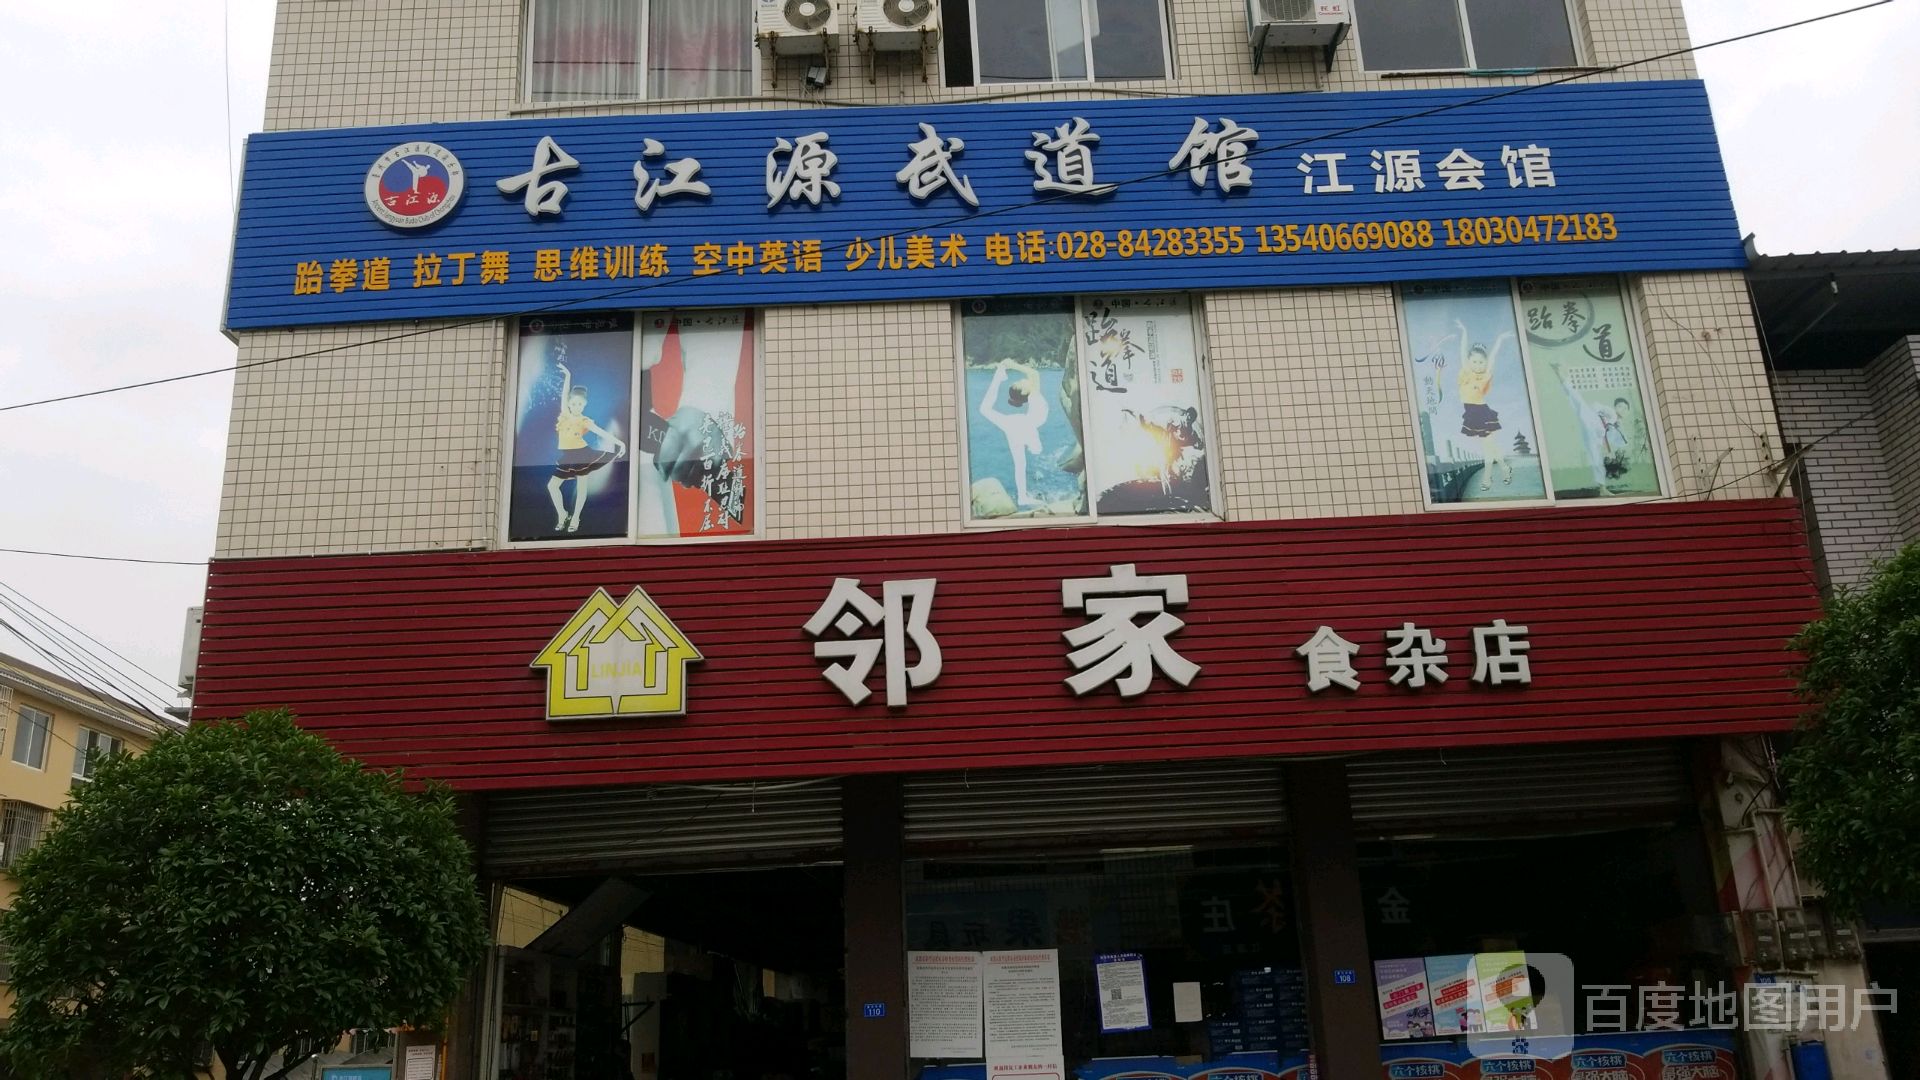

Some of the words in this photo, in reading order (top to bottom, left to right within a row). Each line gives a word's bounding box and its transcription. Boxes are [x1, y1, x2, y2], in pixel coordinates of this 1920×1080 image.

[496, 116, 1259, 217] 古江源武道馆
[1297, 145, 1557, 195] 江源会馆
[294, 257, 390, 295] 跆拳道
[413, 251, 509, 289] 拉丁舞
[534, 245, 670, 282] 思维训练
[693, 240, 822, 276] 空中英语
[845, 233, 968, 272] 少儿美术
[986, 226, 1244, 265] 电话:028-84283355
[1257, 221, 1434, 253] 13540669088
[1443, 213, 1618, 246] 18030472183
[1527, 301, 1626, 363] 跆拳道
[803, 563, 1202, 707] 邻家
[1296, 618, 1532, 693] 食杂店
[591, 662, 642, 678] LINJIA
[868, 1008, 881, 1016] 110
[1576, 1055, 1624, 1067] 六个核桃
[1665, 1051, 1713, 1063] 六个核桃
[1393, 1065, 1441, 1077] 六个核桃
